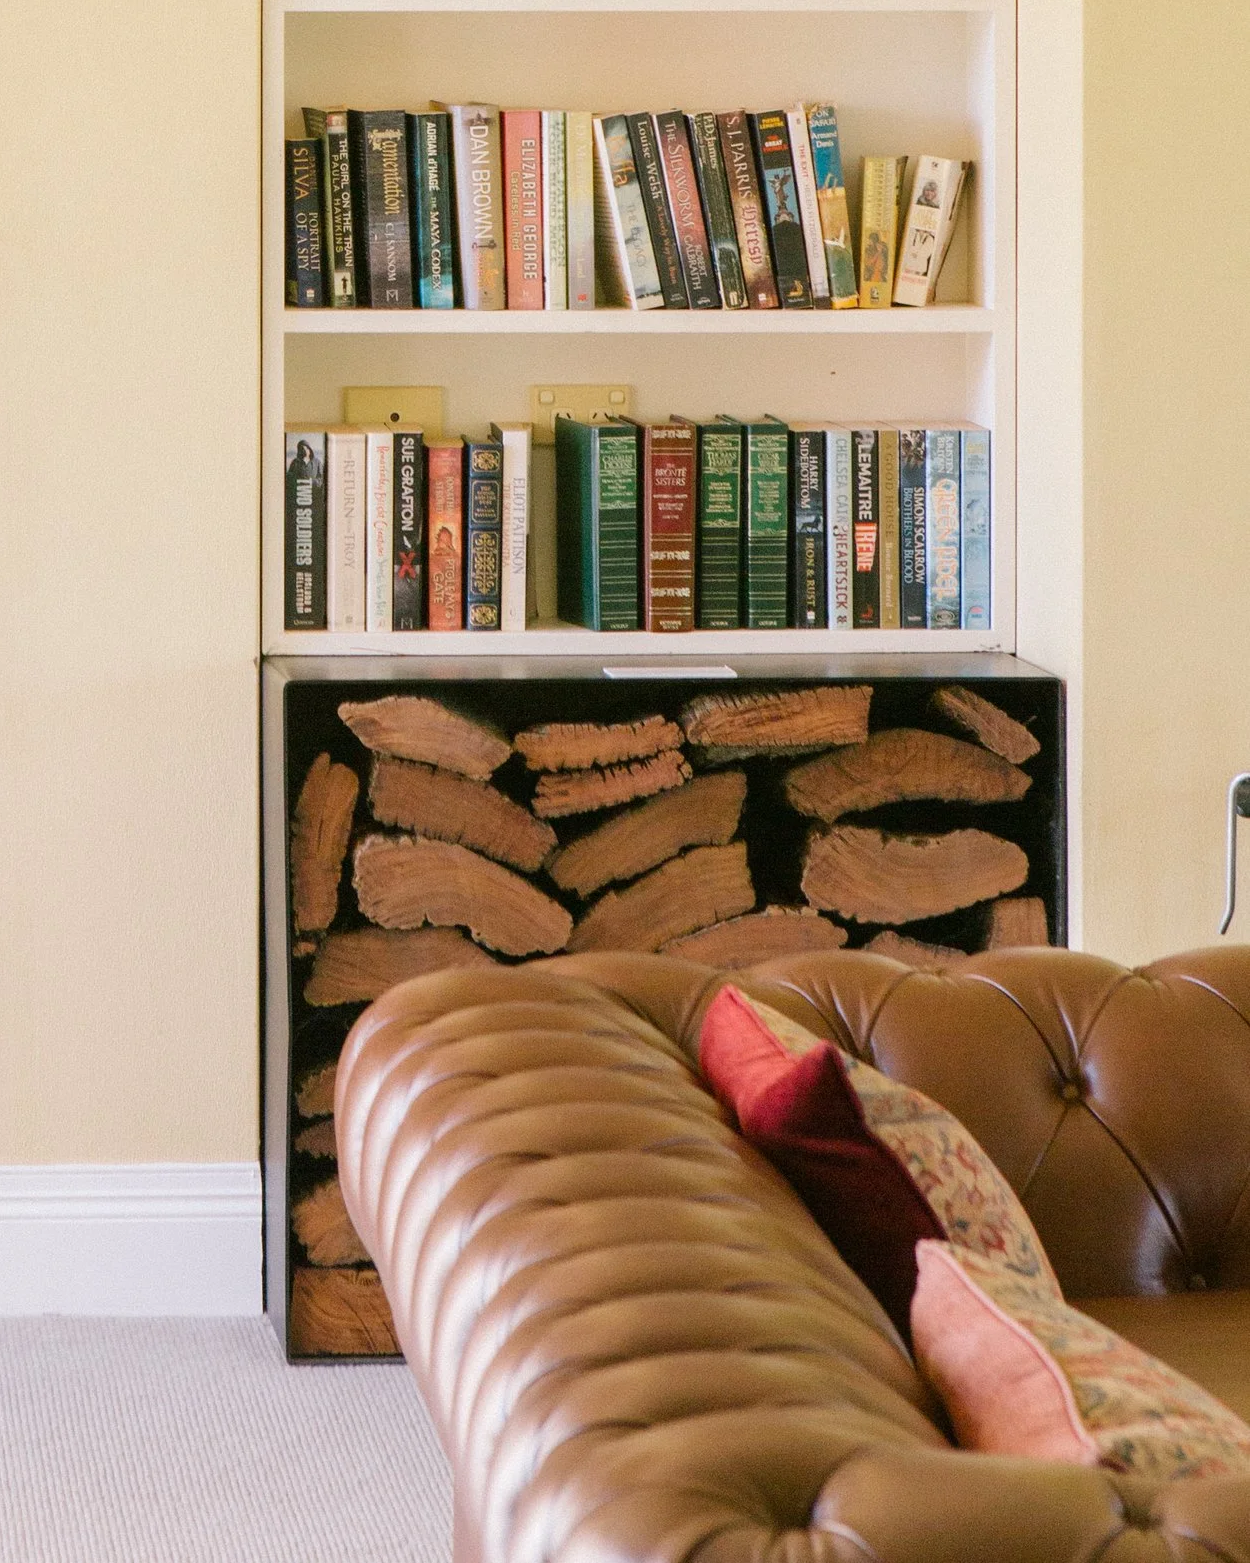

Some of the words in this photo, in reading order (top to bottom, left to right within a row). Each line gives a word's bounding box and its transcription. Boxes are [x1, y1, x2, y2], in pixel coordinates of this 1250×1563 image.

[664, 120, 677, 142] THE
[726, 116, 740, 129] S.
[729, 131, 744, 139] J.
[339, 138, 348, 161] THE
[469, 125, 490, 164] DAN
[638, 121, 654, 159] Louise
[646, 161, 662, 199] Welsh
[797, 145, 806, 159] THE
[293, 148, 309, 200] SILVA
[331, 155, 340, 192] PAULA
[340, 163, 349, 188] GIRL
[367, 128, 405, 215] Lamentation
[521, 139, 537, 218] ELIZABETH
[667, 144, 694, 228] SILKWORM
[730, 143, 751, 199] PARRIS
[799, 161, 808, 178] EXIT
[342, 192, 350, 208] ON
[471, 169, 493, 239] BROWN
[334, 198, 343, 253] HAWKINS
[343, 211, 351, 232] THE
[430, 211, 441, 246] MAYA
[741, 205, 762, 265] Heresy
[308, 212, 321, 272] PORTRAIT
[344, 235, 353, 267] TRAIN
[523, 225, 537, 279] GEORGE
[695, 244, 707, 277] ROBERT
[431, 249, 442, 289] CODEX
[683, 234, 702, 290] GALBRAITH
[401, 437, 414, 463] SUE
[835, 438, 848, 487] CHELSEA
[937, 437, 946, 474] BRITAIN
[945, 436, 955, 474] KRISTEN
[295, 478, 312, 505] TWO
[343, 460, 355, 518] RETURN
[655, 477, 686, 486] SISTERS
[799, 438, 810, 508] SIDEBOTTOM
[809, 455, 818, 491] HARRY
[857, 444, 872, 521] LEMAITRE
[401, 465, 414, 531] GRAFTON
[513, 478, 525, 513] ELIOT
[836, 494, 847, 522] CAIN
[913, 487, 924, 526] SIMON
[932, 478, 958, 543] GREEN
[296, 508, 312, 565] SOLDIERS
[344, 533, 355, 570] TROY
[513, 516, 525, 574] PATTISON
[915, 528, 925, 584] SCARROW
[434, 572, 443, 603] GATE
[835, 533, 847, 610] HEARTSICK
[932, 546, 958, 601] RIDER
